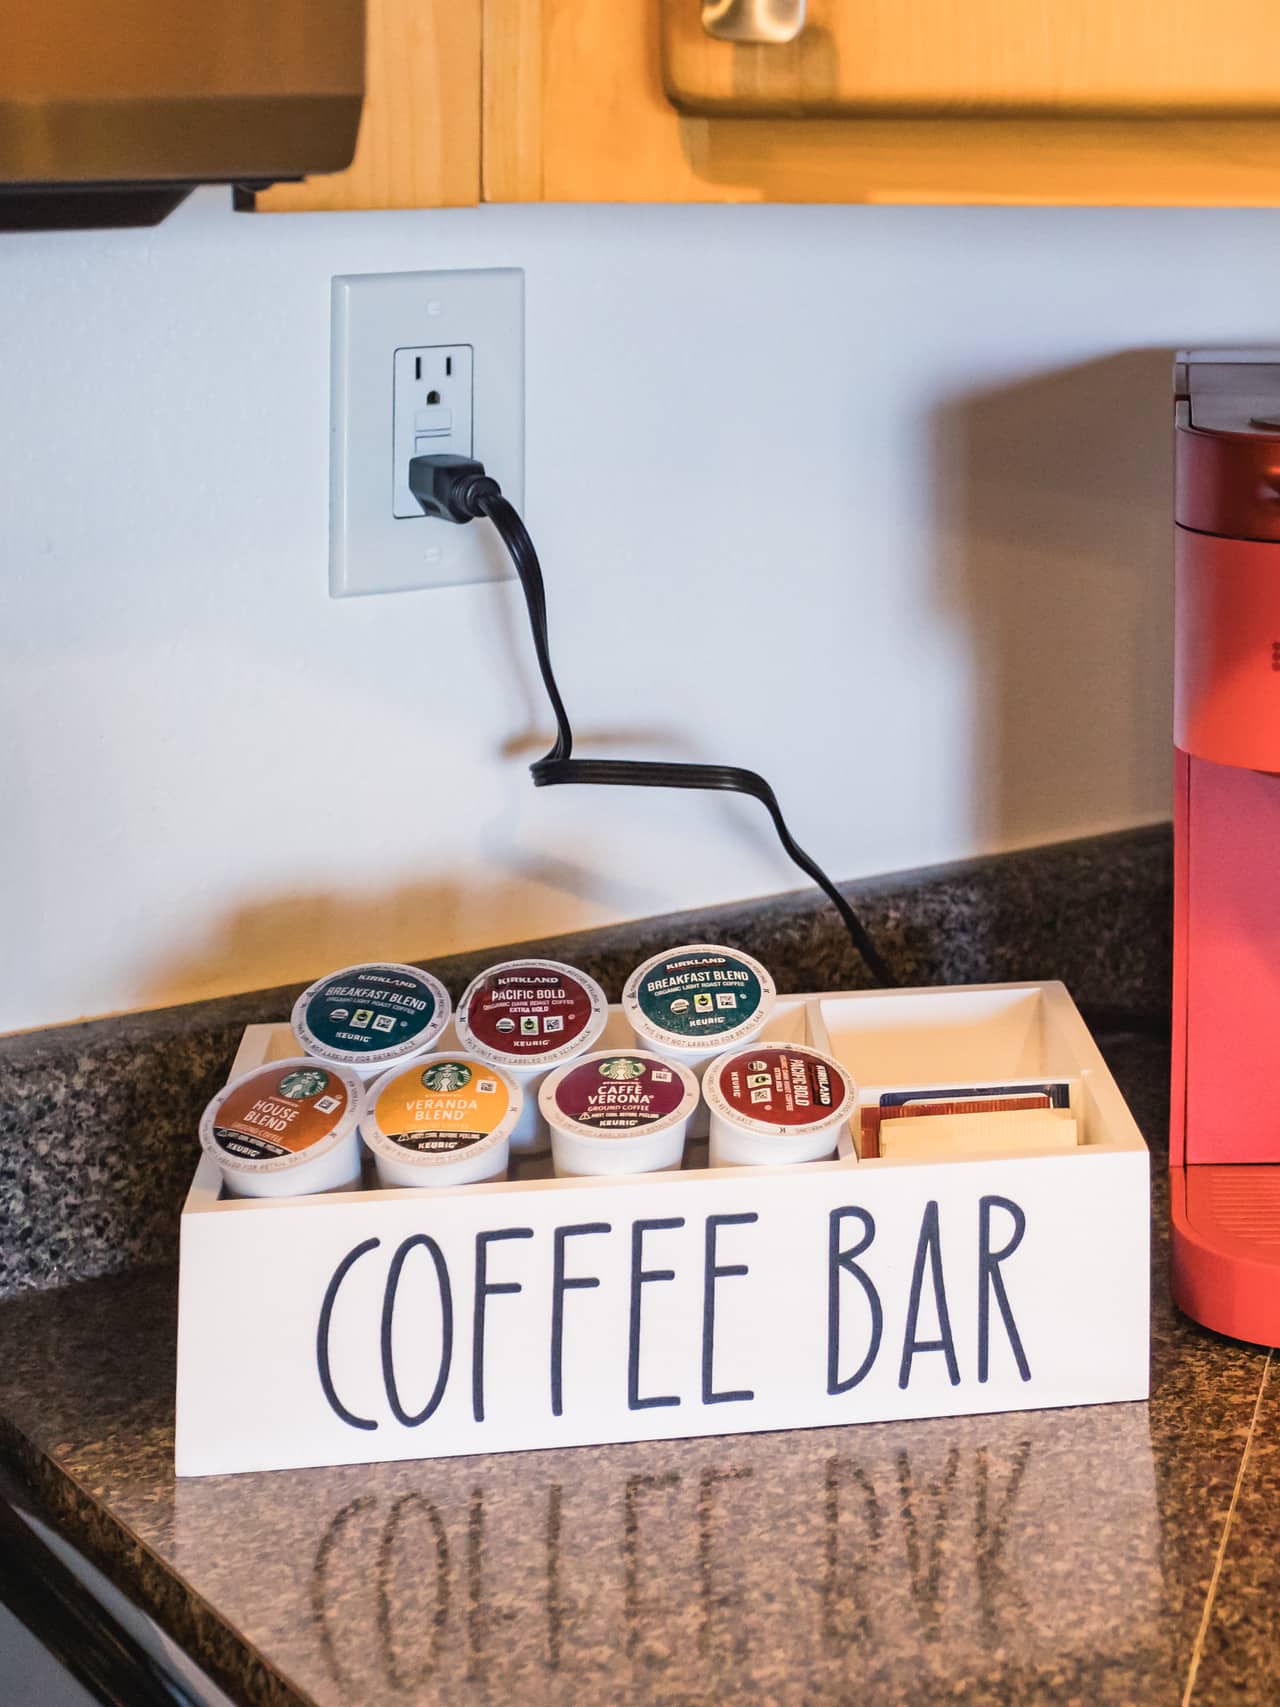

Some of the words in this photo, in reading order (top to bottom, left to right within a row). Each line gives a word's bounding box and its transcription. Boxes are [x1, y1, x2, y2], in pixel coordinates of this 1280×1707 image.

[666, 957, 727, 970] KIRKLAND
[358, 974, 417, 989] KIRKLAND
[498, 977, 559, 985] KIRKLAND
[647, 971, 711, 992] BREAKFAST
[713, 970, 749, 981] BLEND
[324, 986, 390, 1000] BREAKFAST
[389, 993, 427, 1011] BLEND
[492, 989, 534, 1002] PACIFIC
[536, 989, 566, 999] BOLD
[689, 1016, 726, 1027] KEURIG
[335, 1031, 371, 1043] KEURIG
[513, 1039, 551, 1047] KEURIG
[790, 1059, 806, 1084] PACIFIC
[816, 1065, 831, 1105] KIRKLAND
[794, 1085, 809, 1106] BOLD
[252, 1099, 300, 1121] HOUSE
[406, 1099, 478, 1111] VERANDA
[243, 1110, 287, 1131] BLEND
[415, 1110, 465, 1121] BLEND
[418, 1141, 458, 1149] KEURIG
[316, 1212, 759, 1430] COFFEE
[827, 1195, 1031, 1395] BAR
